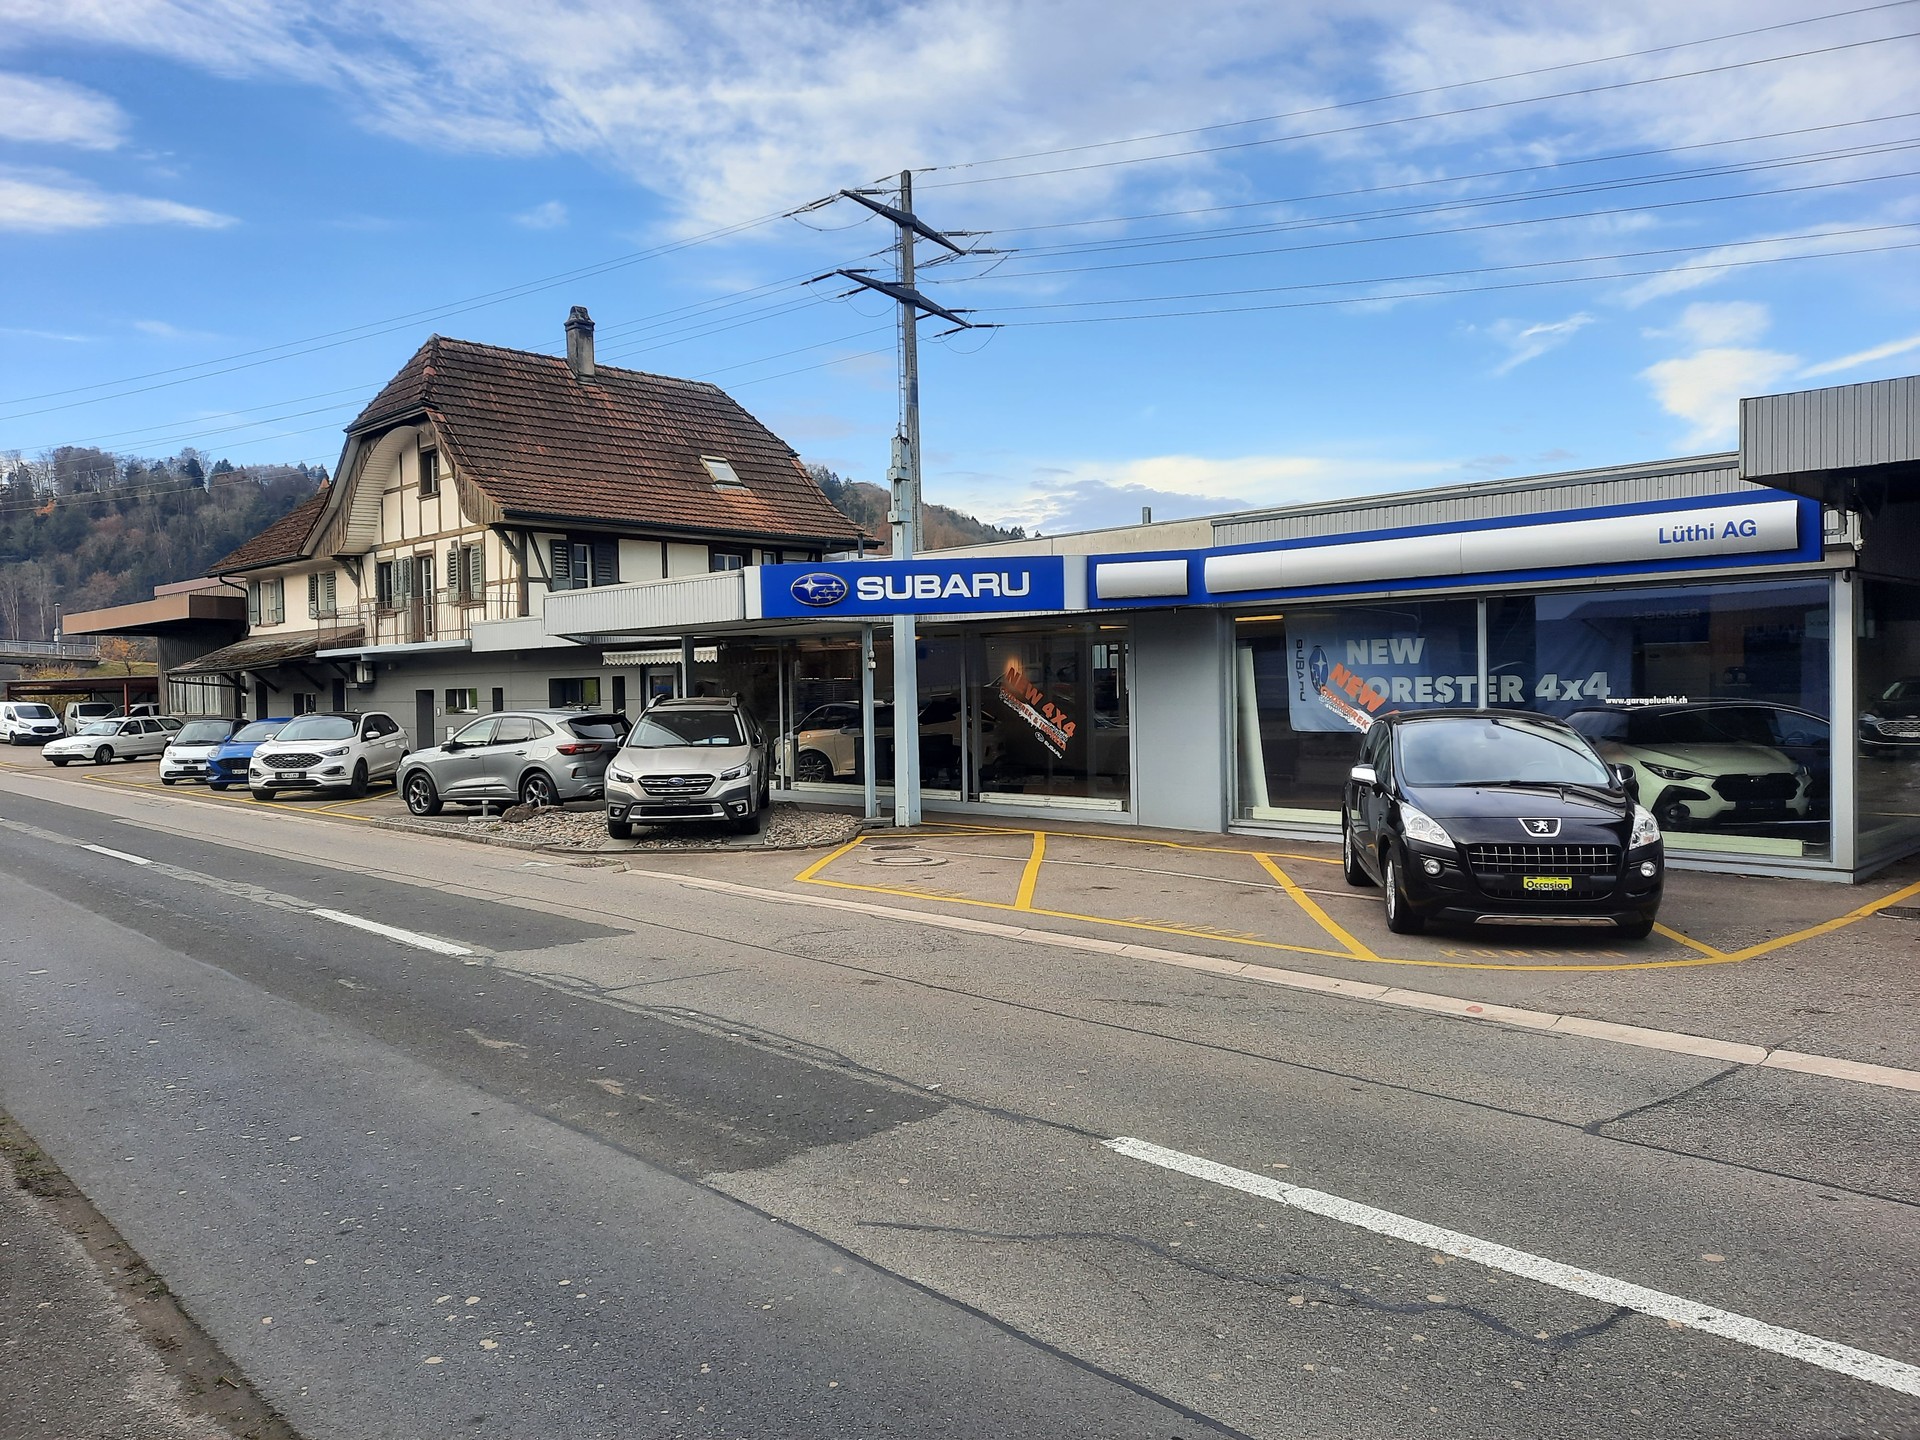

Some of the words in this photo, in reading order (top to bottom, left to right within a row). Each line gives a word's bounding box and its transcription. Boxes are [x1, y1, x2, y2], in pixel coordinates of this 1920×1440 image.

[1659, 523, 1715, 544] Lüthi
[1722, 519, 1757, 539] AG
[857, 572, 1031, 601] SUBARU
[1347, 638, 1425, 665] NEW
[1006, 667, 1043, 706] NEW
[1330, 663, 1386, 713] NEW
[1349, 675, 1525, 703] ORESTER
[1535, 671, 1611, 702] 4x4
[1605, 695, 1688, 706] www.garageluethi.ch
[1526, 880, 1570, 889] Occasion
